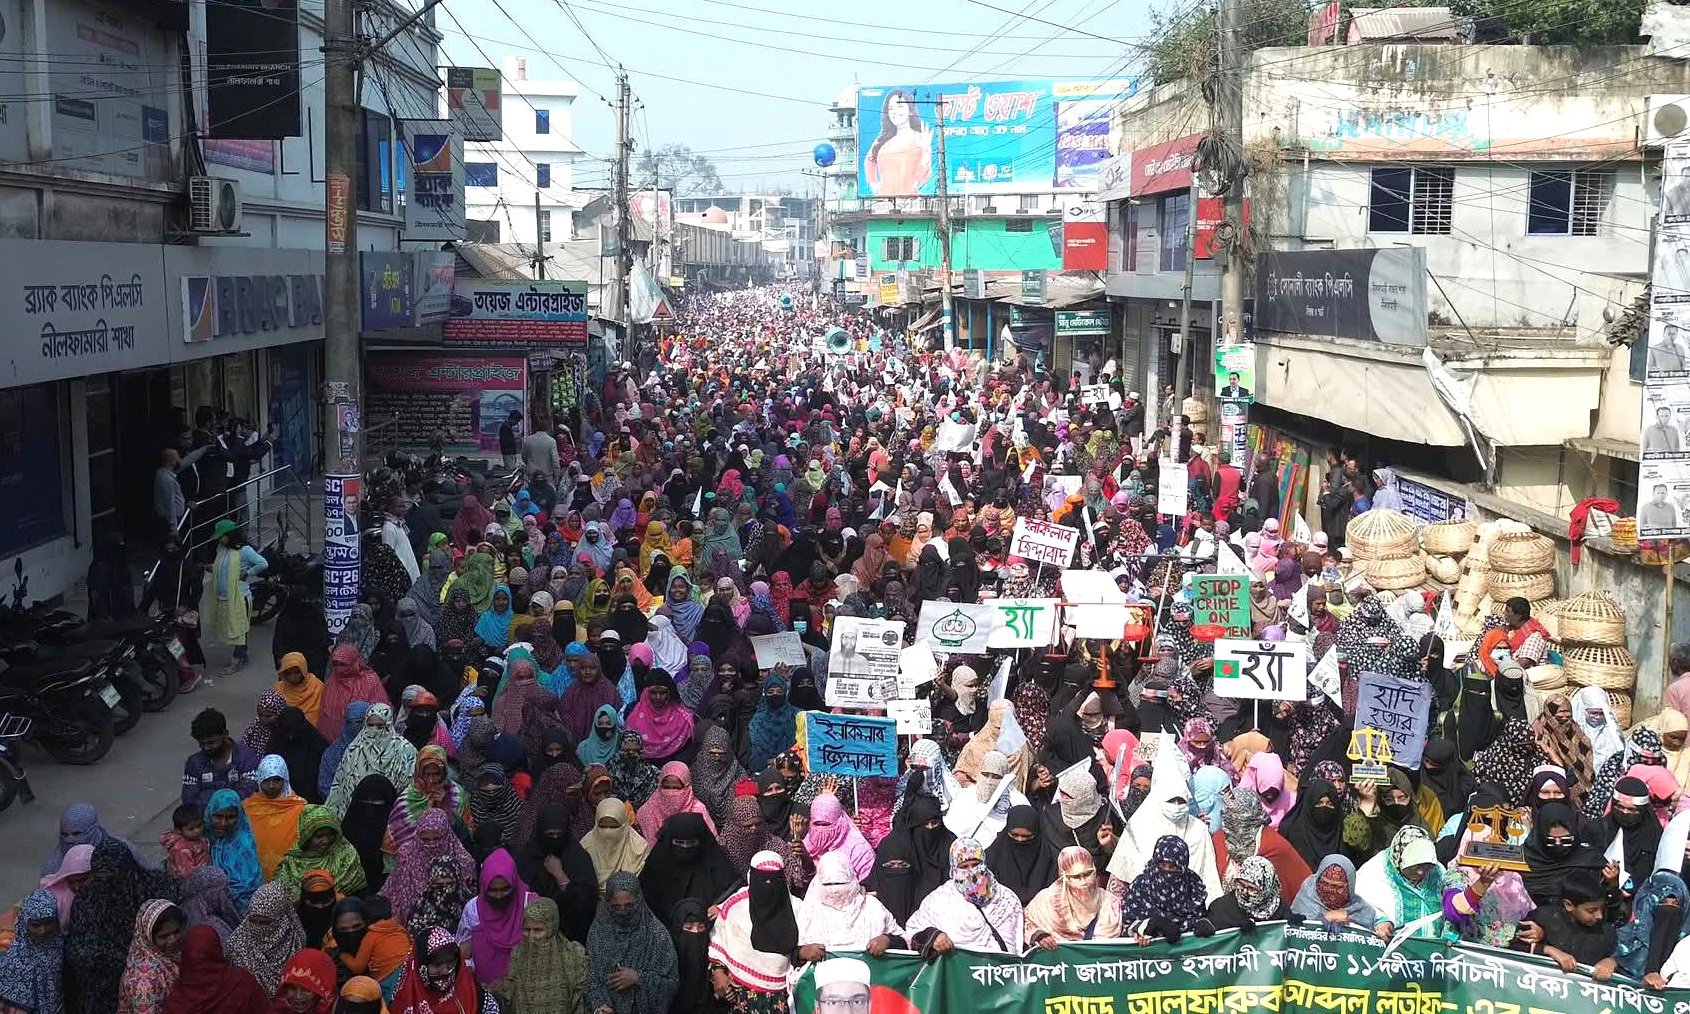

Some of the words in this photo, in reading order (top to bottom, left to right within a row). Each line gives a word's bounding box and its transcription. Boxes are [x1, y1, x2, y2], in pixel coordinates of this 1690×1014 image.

[24, 285, 58, 314] ব্র্যাক
[61, 284, 98, 310] ব্যাংক
[100, 273, 143, 309] পিএলসি
[1305, 277, 1324, 298] ব্যাংক
[1325, 271, 1353, 298] পিএলসি
[474, 291, 511, 312] তয়েজ
[515, 285, 584, 314] এন্টারপ্রাইজ
[41, 318, 109, 358] নীলফামারী
[111, 325, 135, 350] শাখা
[1024, 518, 1078, 544] ইনকিলাব
[1018, 534, 1068, 567] জিন্দাবাদ
[325, 569, 359, 584] SC'26
[1198, 579, 1241, 597] STOP
[1196, 597, 1240, 611] CRIME
[1208, 611, 1230, 624] ON
[1225, 626, 1251, 637] MEN
[1231, 642, 1294, 692] হ্যাঁ
[1366, 683, 1422, 713] হাদি
[814, 716, 887, 743] ইনকিলাব
[1369, 706, 1419, 731] হত্যার
[817, 744, 886, 775] জিন্দাবাদ
[969, 961, 1069, 987] বাংলাদেশ
[1073, 959, 1174, 985] জামায়াতে
[1347, 954, 1374, 976] ১১
[1377, 952, 1427, 980] দলীয়
[1429, 952, 1510, 990] নির্বাচনী
[1516, 963, 1574, 998] ঐক্য
[1579, 980, 1667, 1014] সমর্থিত
